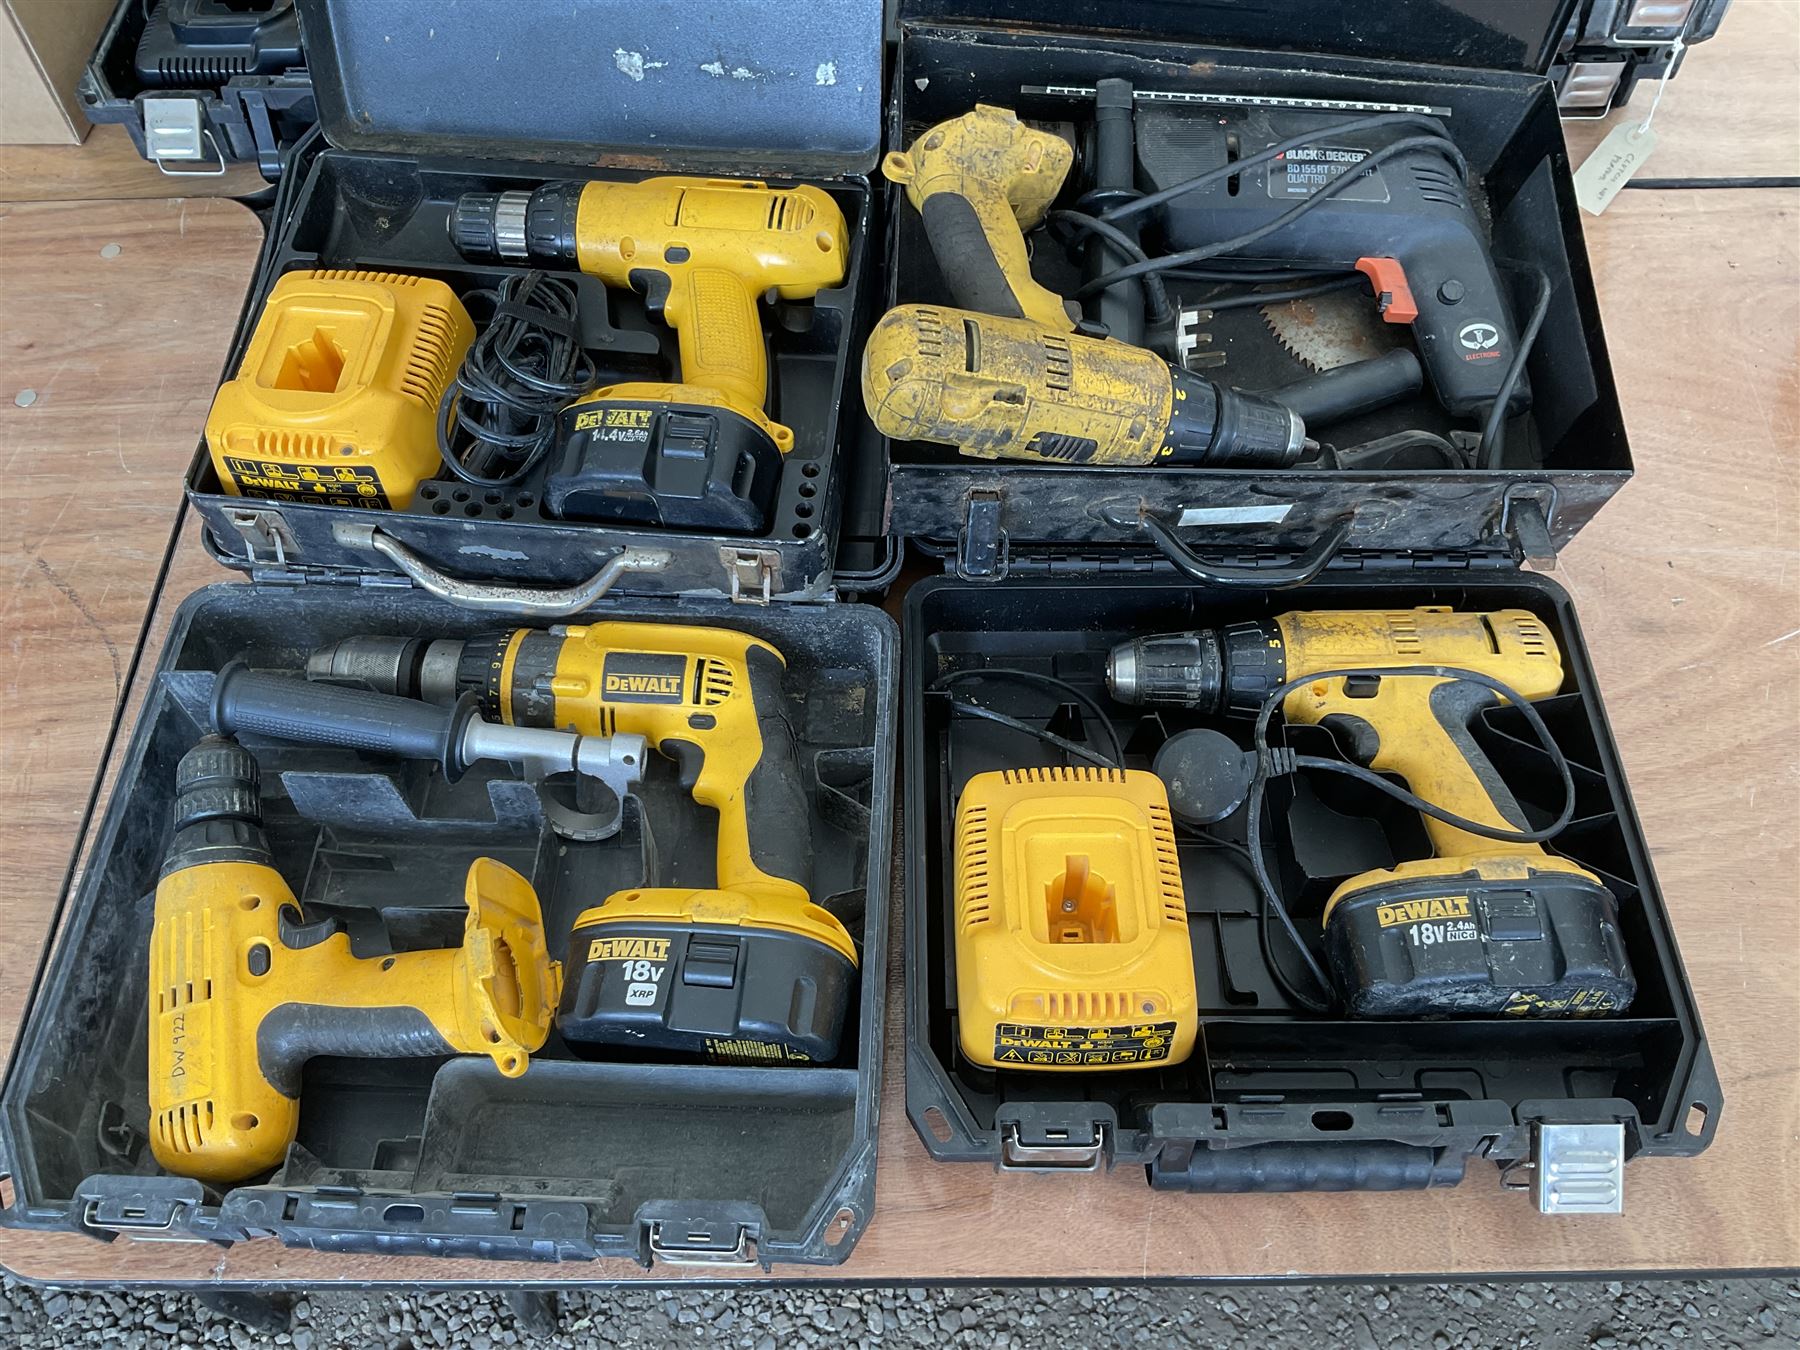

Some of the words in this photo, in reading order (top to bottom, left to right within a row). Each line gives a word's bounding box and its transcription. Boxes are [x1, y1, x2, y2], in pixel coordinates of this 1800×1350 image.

[1287, 174, 1327, 184] QUATTRO
[1446, 921, 1476, 931] 2.4Ah
[630, 989, 654, 999] XRP
[172, 1013, 185, 1045] 922
